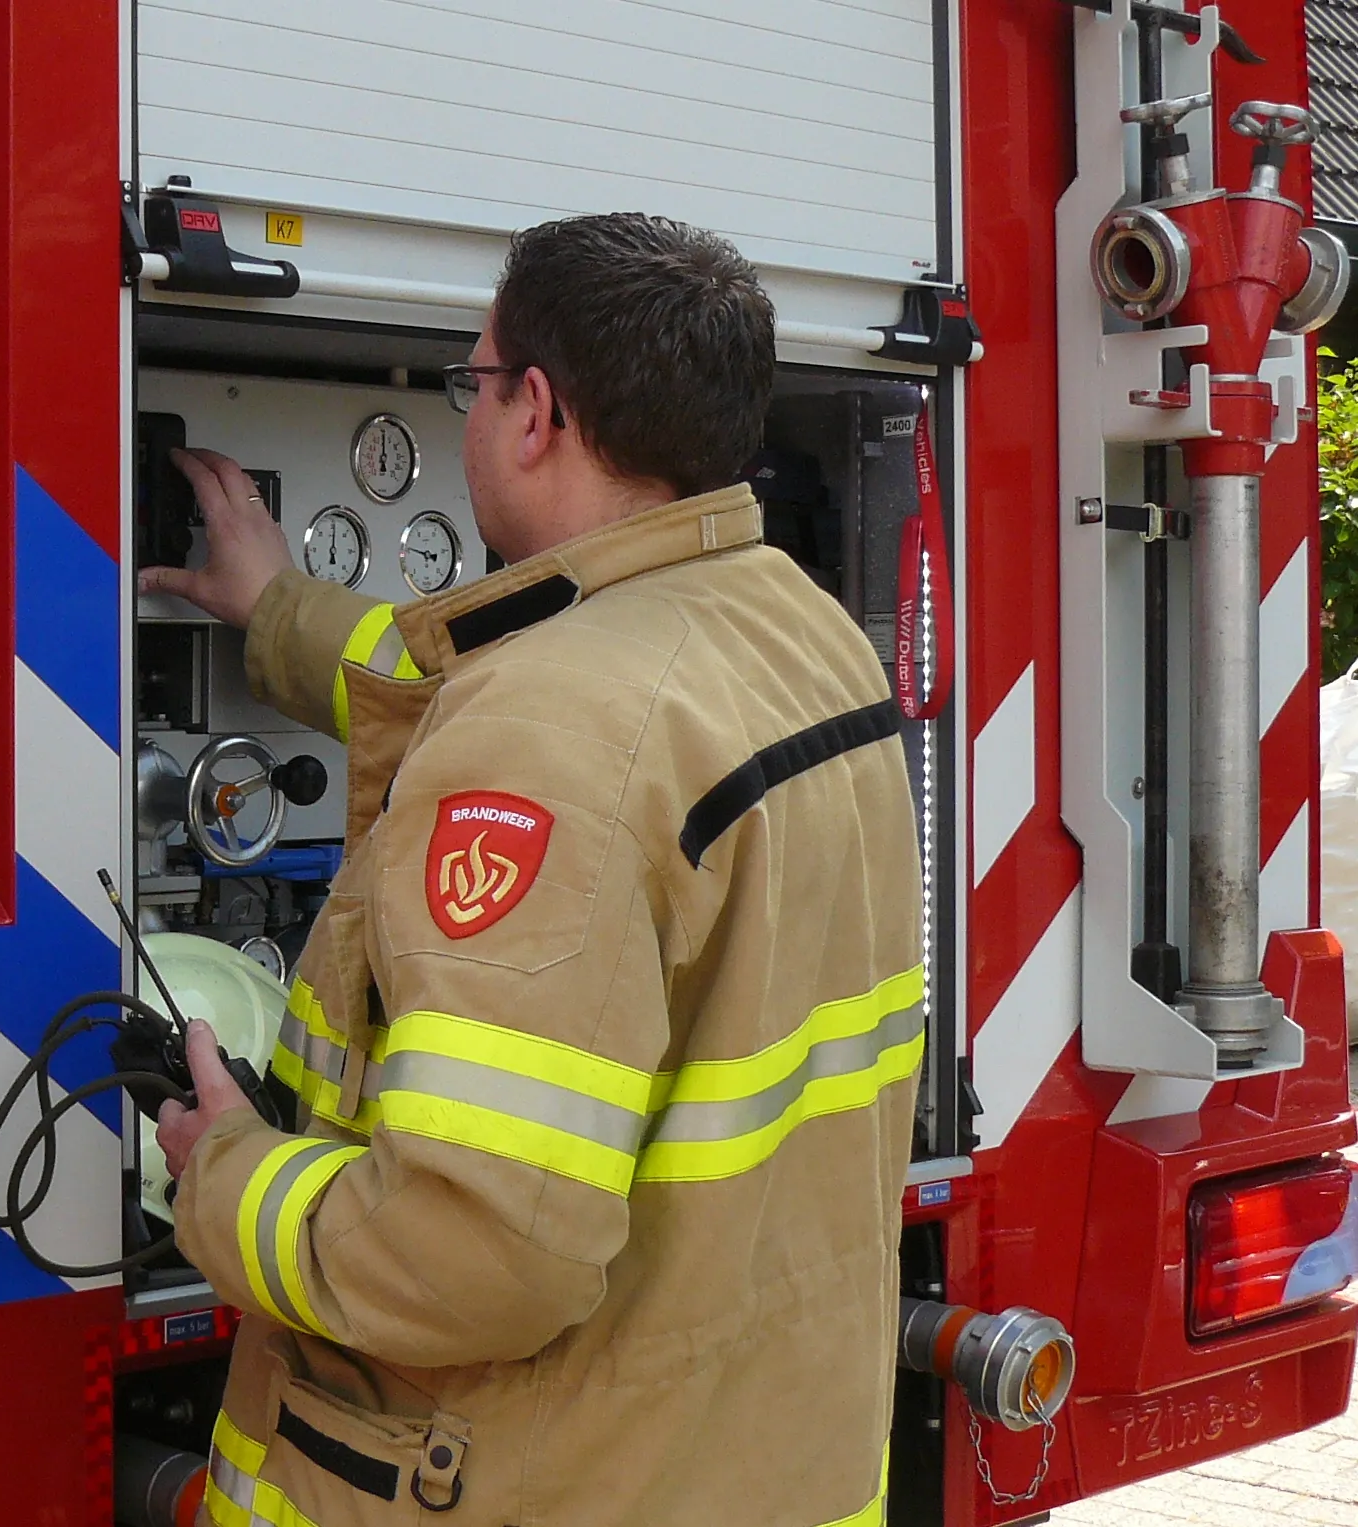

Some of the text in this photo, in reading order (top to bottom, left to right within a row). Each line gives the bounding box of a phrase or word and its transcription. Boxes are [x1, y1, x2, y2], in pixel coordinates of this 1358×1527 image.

[276, 219, 295, 239] K7
[885, 419, 911, 433] 2400
[451, 806, 536, 832] BRANDWEER
